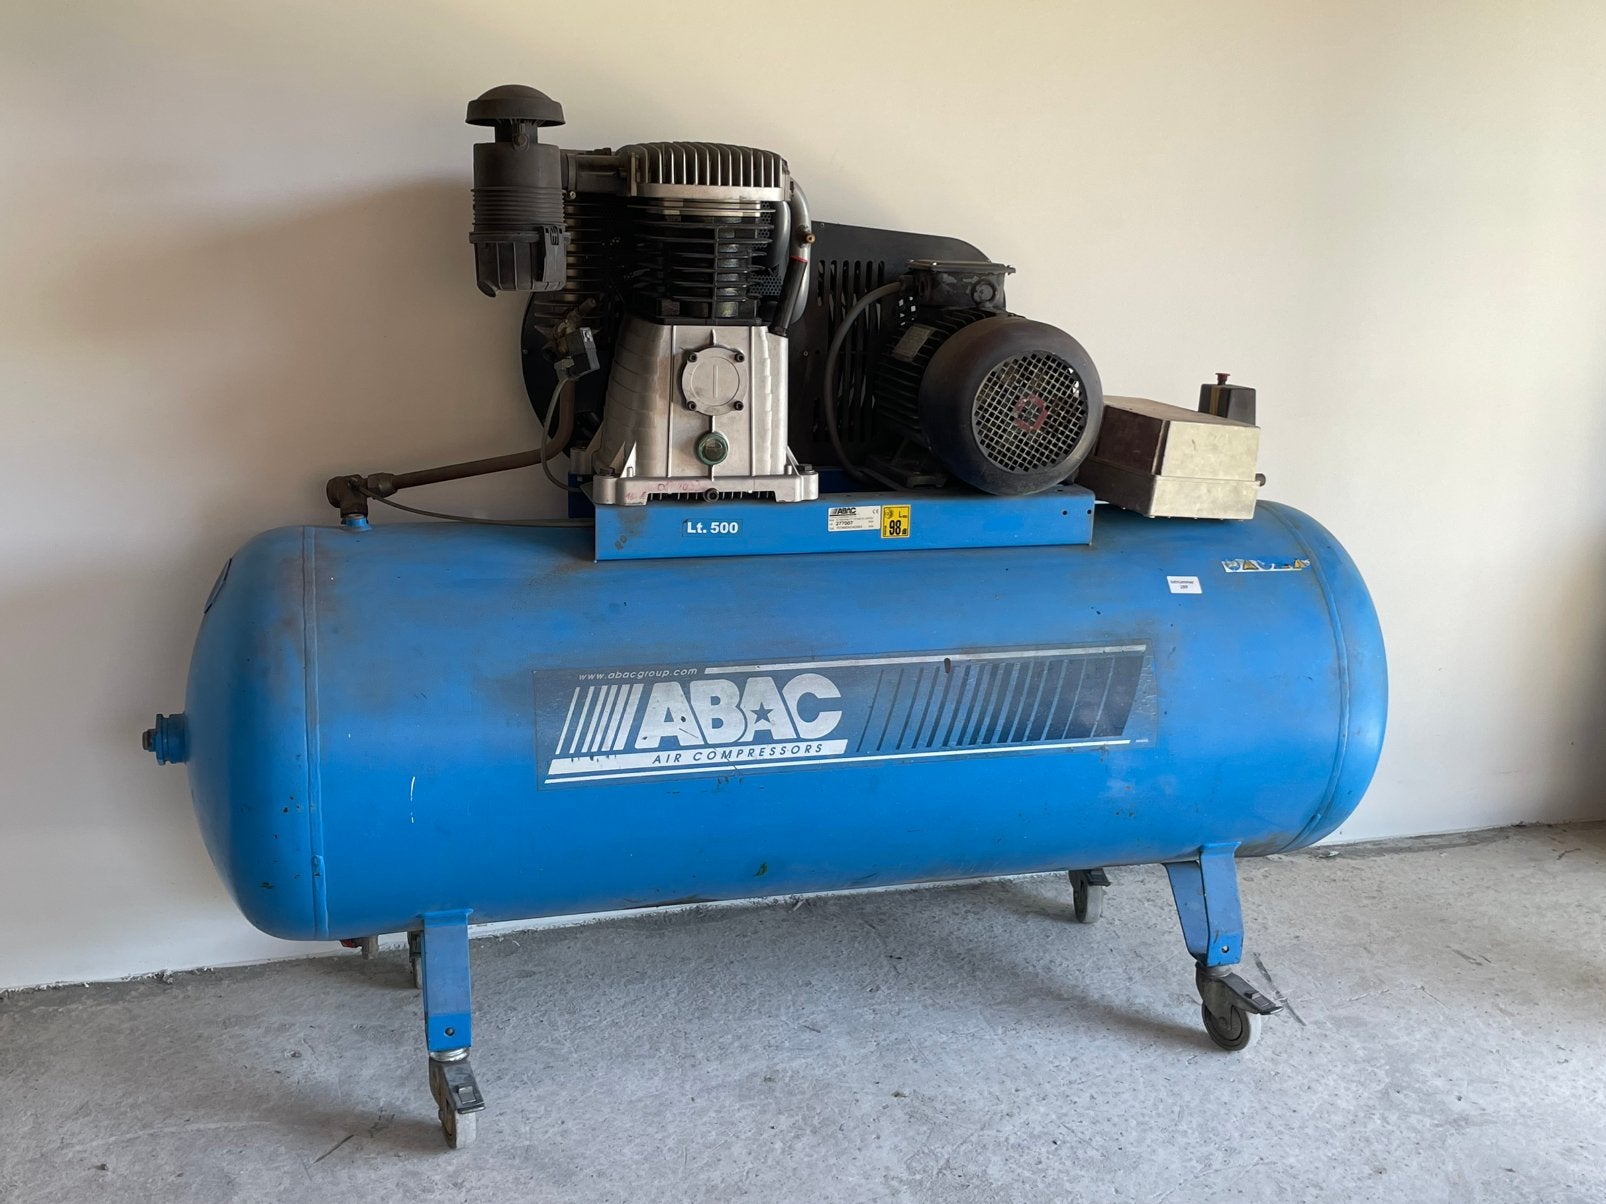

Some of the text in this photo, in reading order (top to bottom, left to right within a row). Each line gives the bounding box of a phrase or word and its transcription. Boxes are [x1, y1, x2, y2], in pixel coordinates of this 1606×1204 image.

[687, 521, 739, 534] Lt. 500
[889, 519, 901, 535] 98
[579, 668, 698, 680] www.abacgroup.com
[635, 673, 842, 749] ABAC
[652, 744, 823, 764] AIR COMPRESSORS
